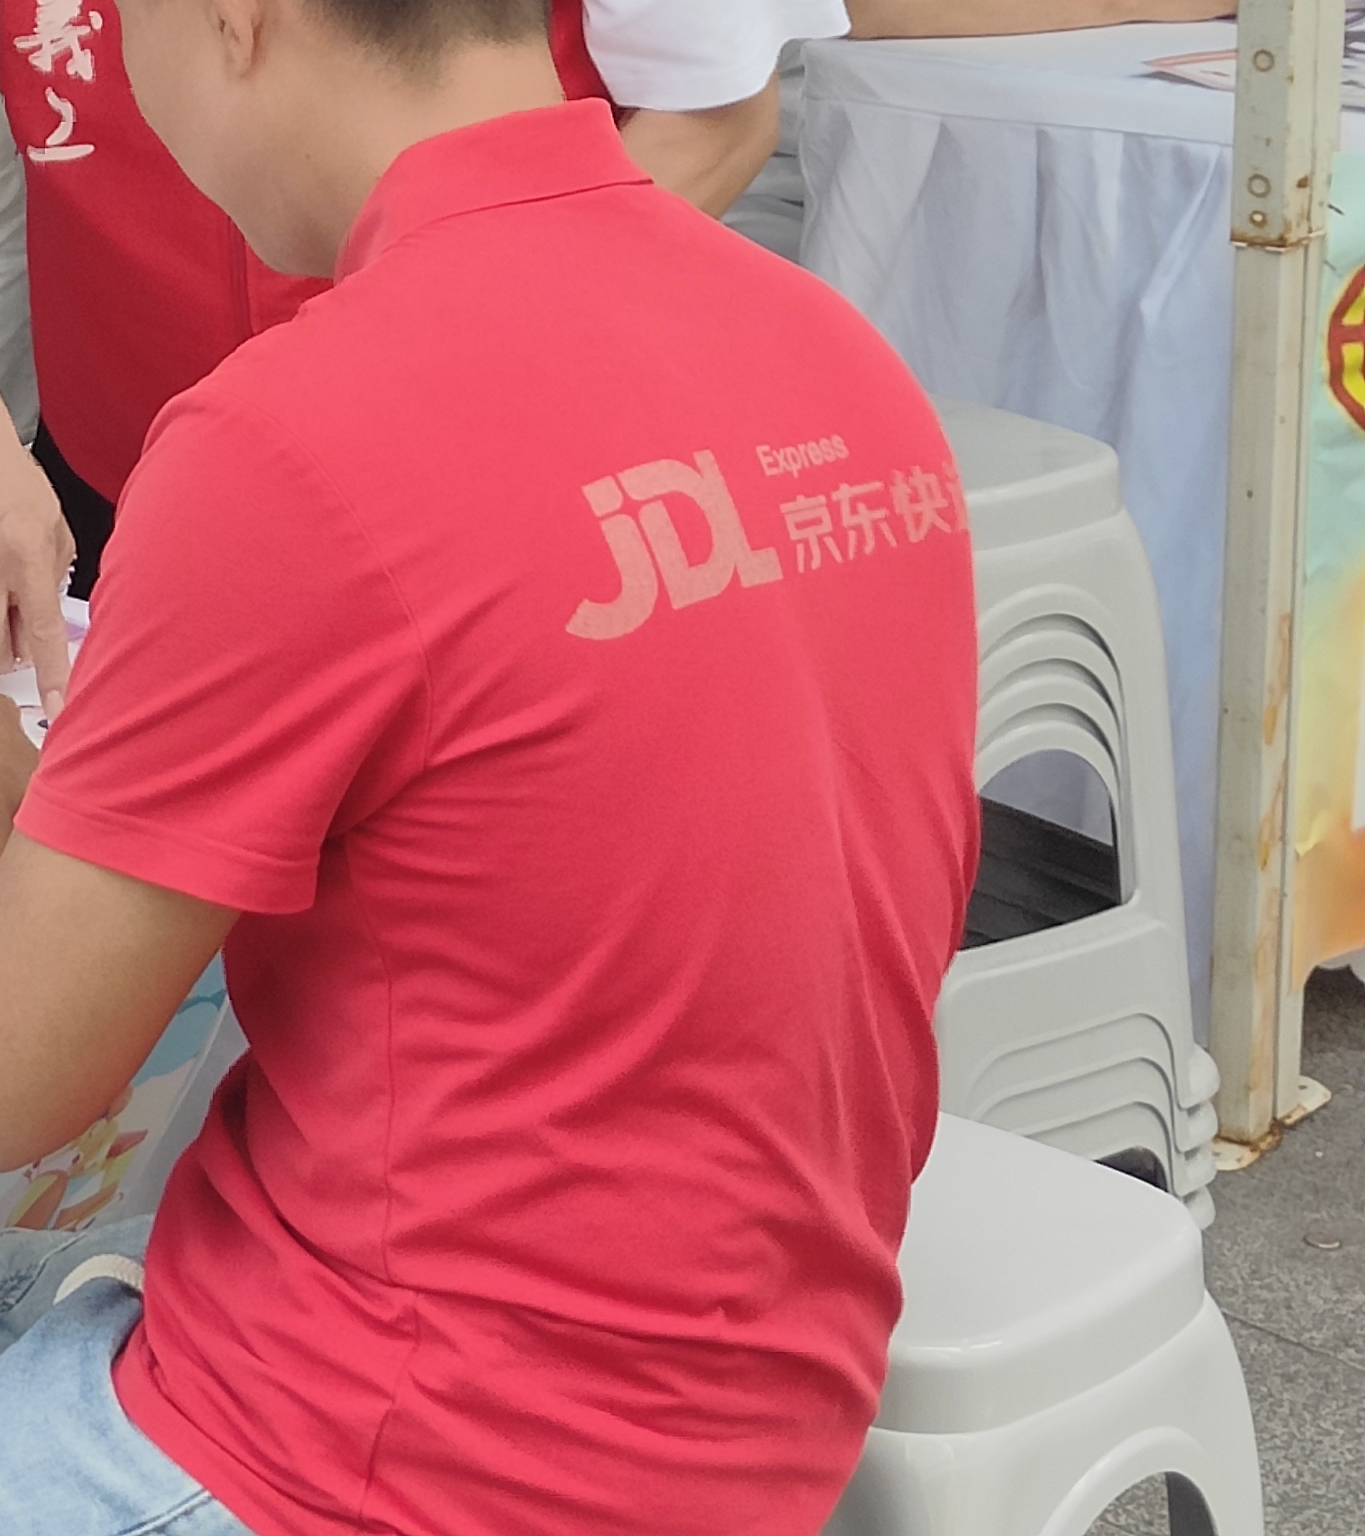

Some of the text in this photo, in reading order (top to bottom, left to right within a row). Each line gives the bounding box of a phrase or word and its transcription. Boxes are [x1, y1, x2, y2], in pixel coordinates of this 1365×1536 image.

[756, 434, 849, 478] Express
[565, 449, 784, 641] JDL
[780, 462, 971, 574] 京东快
